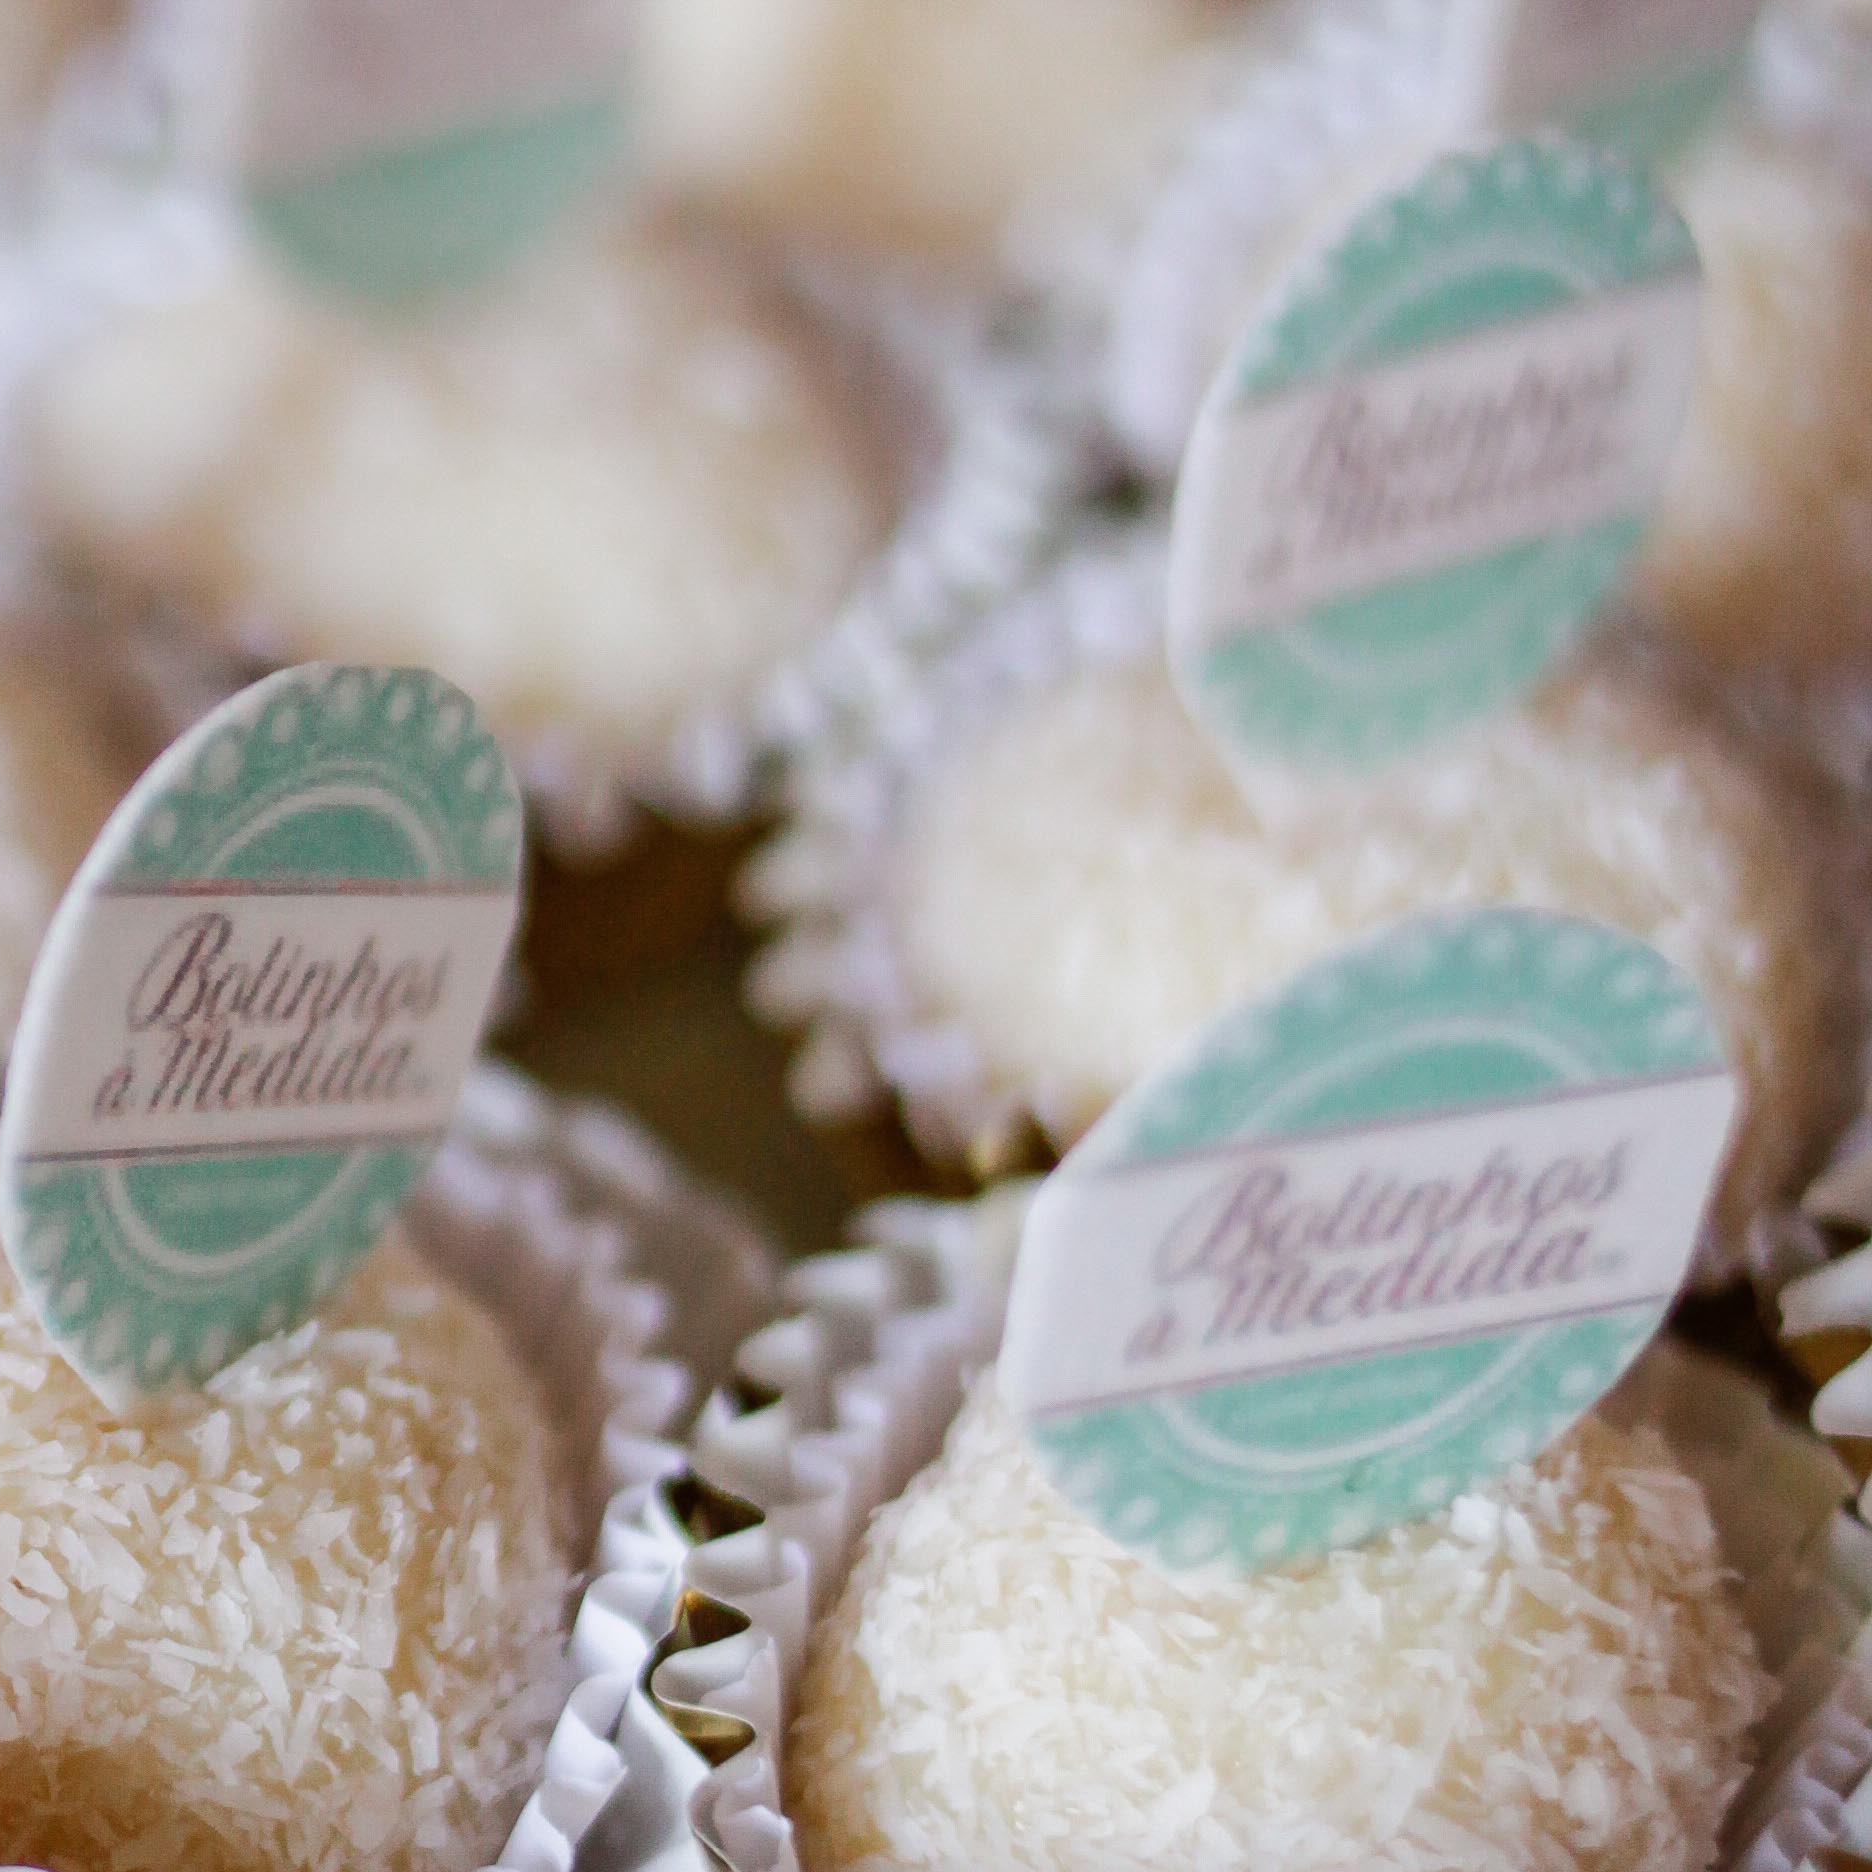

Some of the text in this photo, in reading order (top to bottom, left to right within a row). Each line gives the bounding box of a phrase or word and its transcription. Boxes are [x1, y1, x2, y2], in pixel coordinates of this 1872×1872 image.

[128, 911, 450, 1034] Bolinhos
[146, 1021, 416, 1112] Medida
[1152, 1136, 1628, 1283] Bolinhos
[1204, 1226, 1594, 1343] Medida
